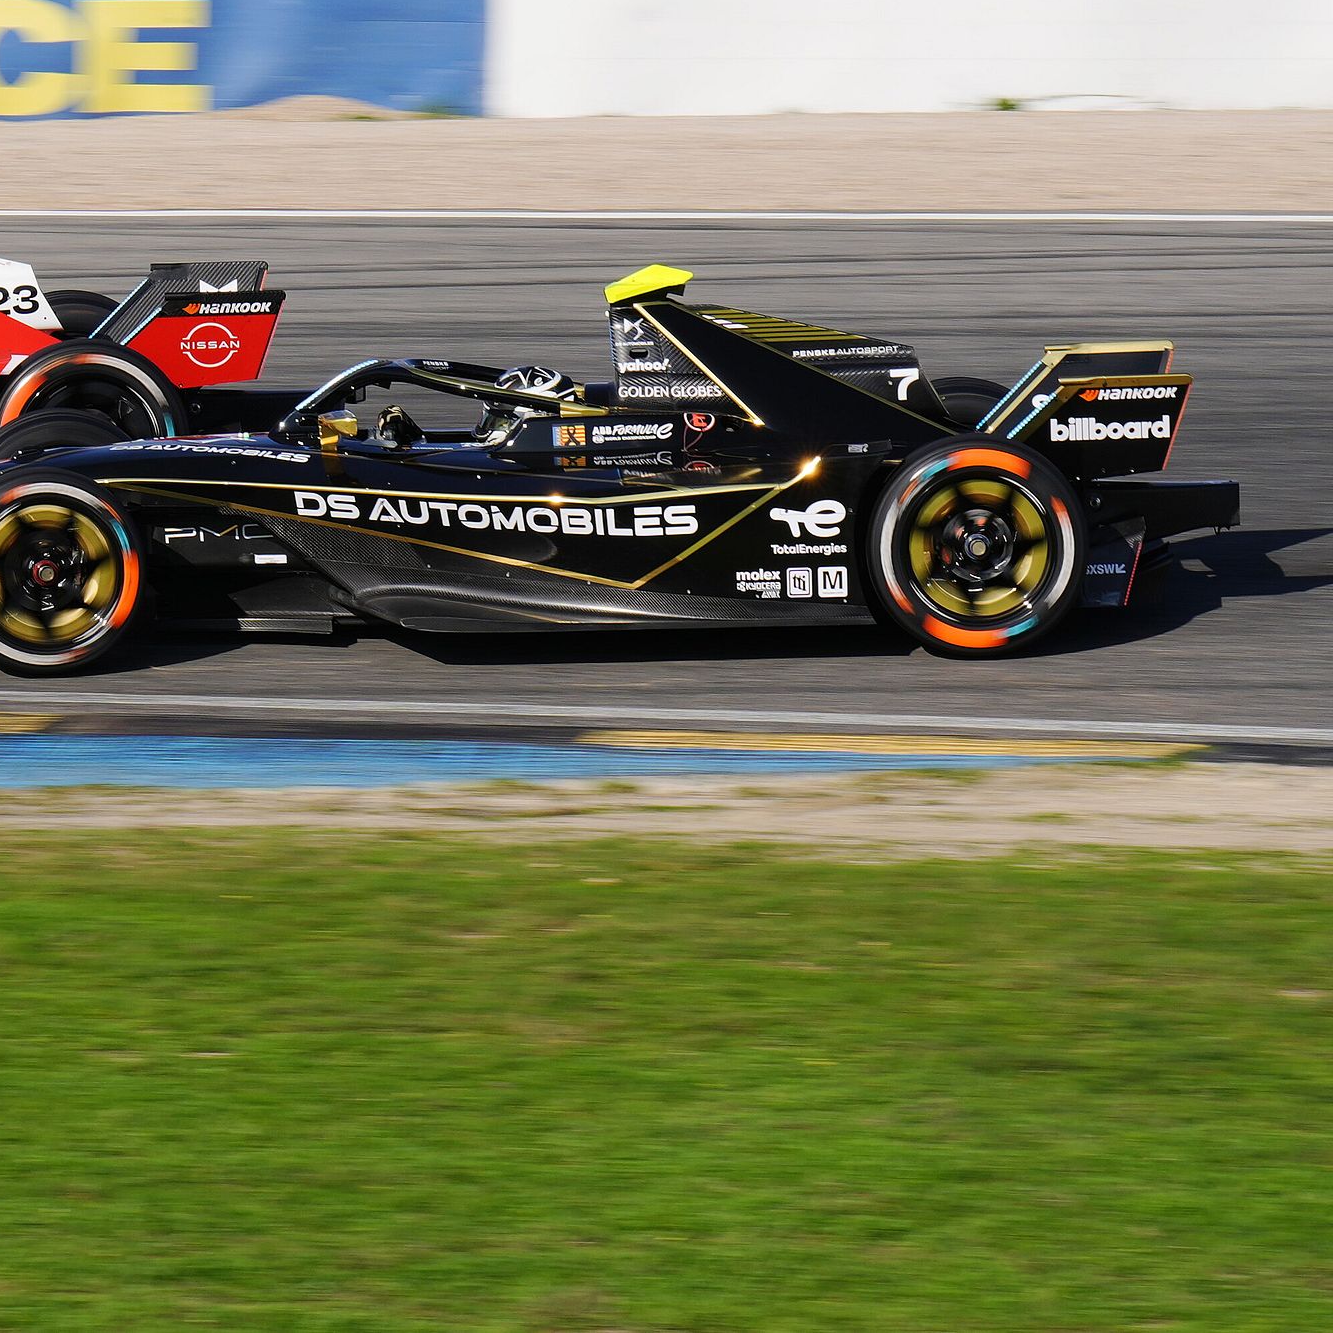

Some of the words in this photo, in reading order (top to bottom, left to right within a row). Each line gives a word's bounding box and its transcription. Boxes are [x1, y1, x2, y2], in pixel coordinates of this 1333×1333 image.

[181, 340, 240, 350] NISSAN
[618, 386, 671, 398] GOLDEN
[671, 385, 722, 398] GLOBES
[889, 368, 919, 401] 7
[1050, 415, 1171, 442] billboard
[149, 444, 311, 463] AUTOMOBILES
[294, 491, 360, 519] DS
[368, 497, 699, 537] AUTOMOBILES
[770, 543, 848, 556] TotalEnergies
[736, 568, 781, 581] molex
